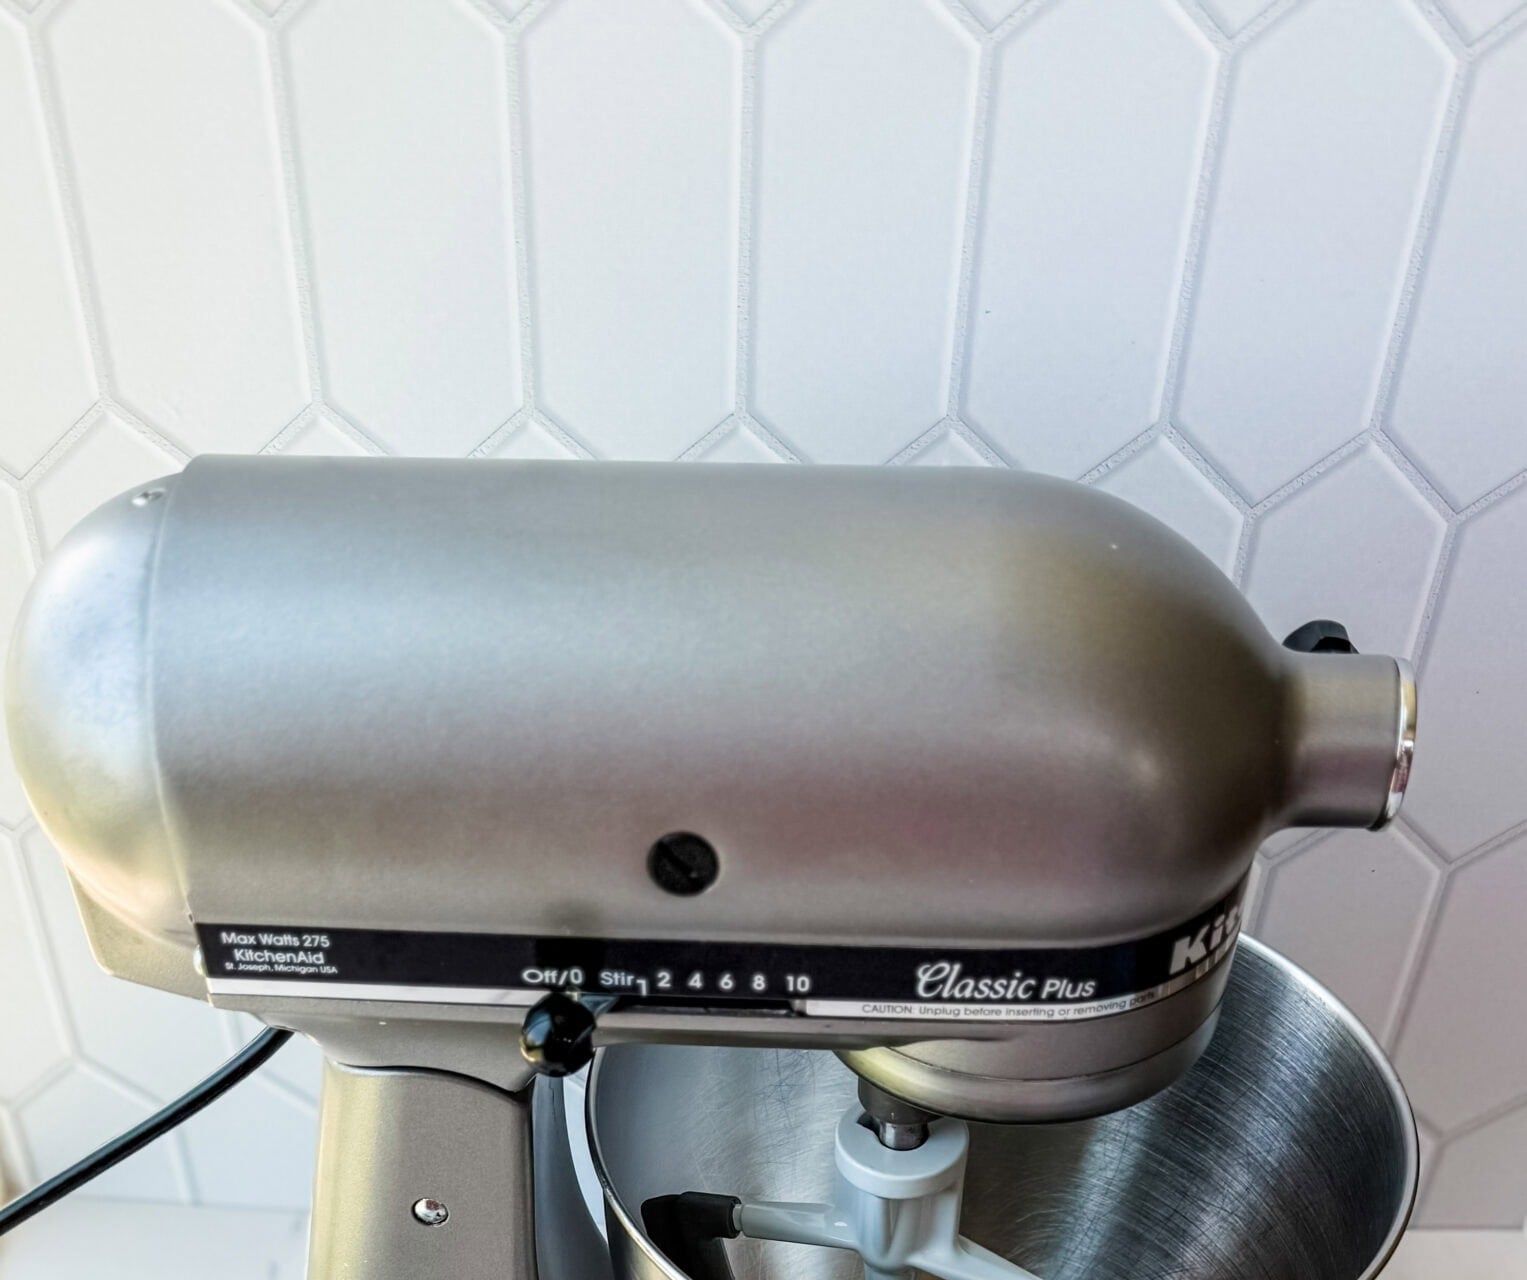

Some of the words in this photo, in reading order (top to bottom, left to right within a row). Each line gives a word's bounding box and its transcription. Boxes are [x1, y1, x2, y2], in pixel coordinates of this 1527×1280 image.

[221, 931, 257, 946] Max
[258, 933, 300, 947] Watts
[302, 934, 330, 948] 275
[233, 949, 325, 964] KitchenAid
[275, 963, 318, 974] Michigan
[320, 965, 338, 974] USA
[522, 968, 583, 986] Off/0
[600, 970, 634, 986] Stir
[657, 971, 671, 988] 2
[687, 973, 703, 990] 4
[719, 974, 734, 990] 6
[752, 974, 767, 991] 8
[786, 975, 810, 993] 10
[916, 961, 1037, 1000] Classic
[1041, 979, 1096, 999] Plus
[919, 1006, 960, 1018] Unplug
[964, 1007, 1002, 1017] before
[1006, 1007, 1055, 1017] inserting
[1058, 1008, 1070, 1016] or
[1074, 1000, 1127, 1015] removing
